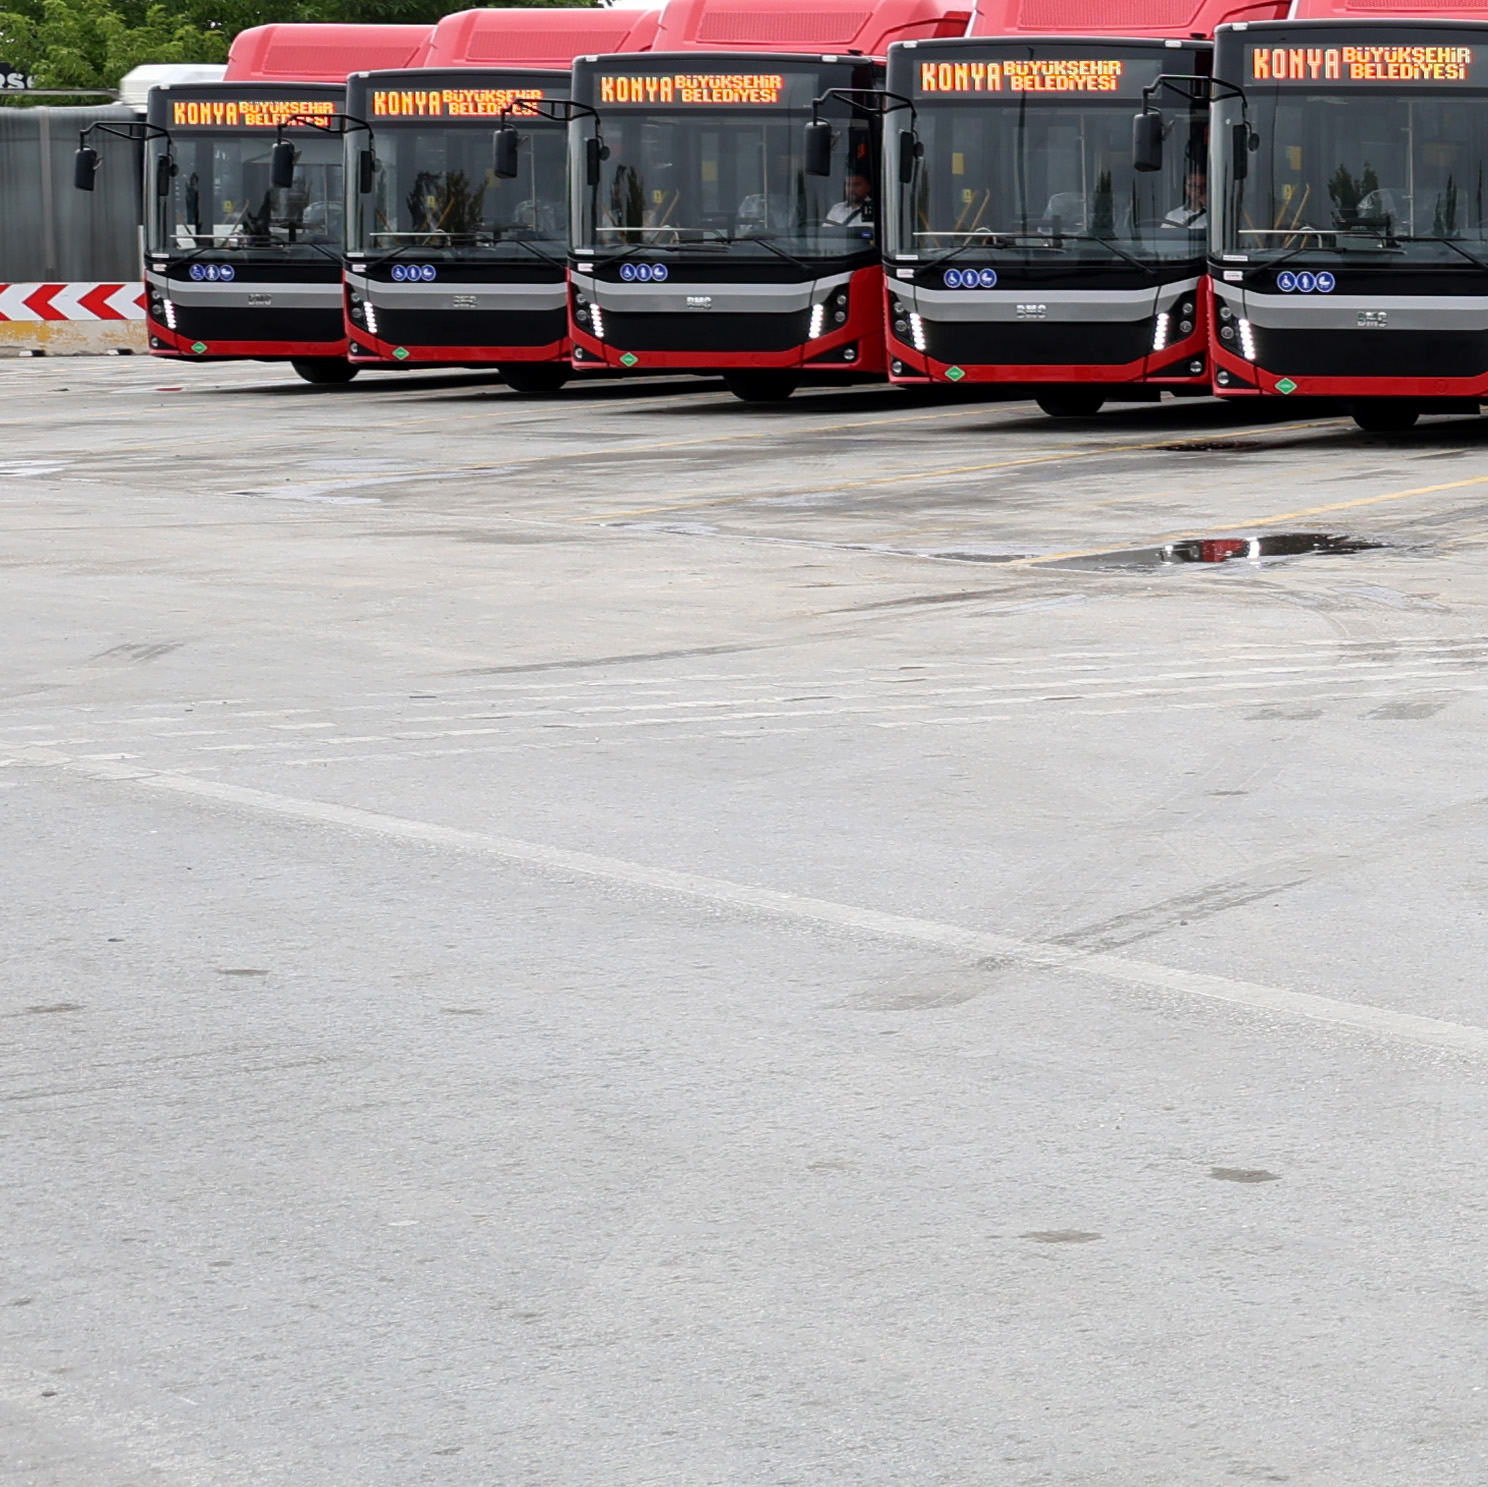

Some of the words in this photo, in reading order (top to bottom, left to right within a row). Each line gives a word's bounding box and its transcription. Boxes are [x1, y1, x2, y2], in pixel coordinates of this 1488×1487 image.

[1254, 48, 1340, 79] KONYA
[1342, 47, 1471, 64] BÜYÜKŞEHİR
[922, 63, 1001, 91] KONYA
[1350, 63, 1465, 79] BELEDİYESİ
[601, 77, 673, 102] KONYA
[1010, 75, 1116, 91] BELEDİYESİ
[374, 92, 441, 115] KONYA
[681, 88, 777, 103] BELEDİYESİ
[174, 102, 238, 125] KONYA
